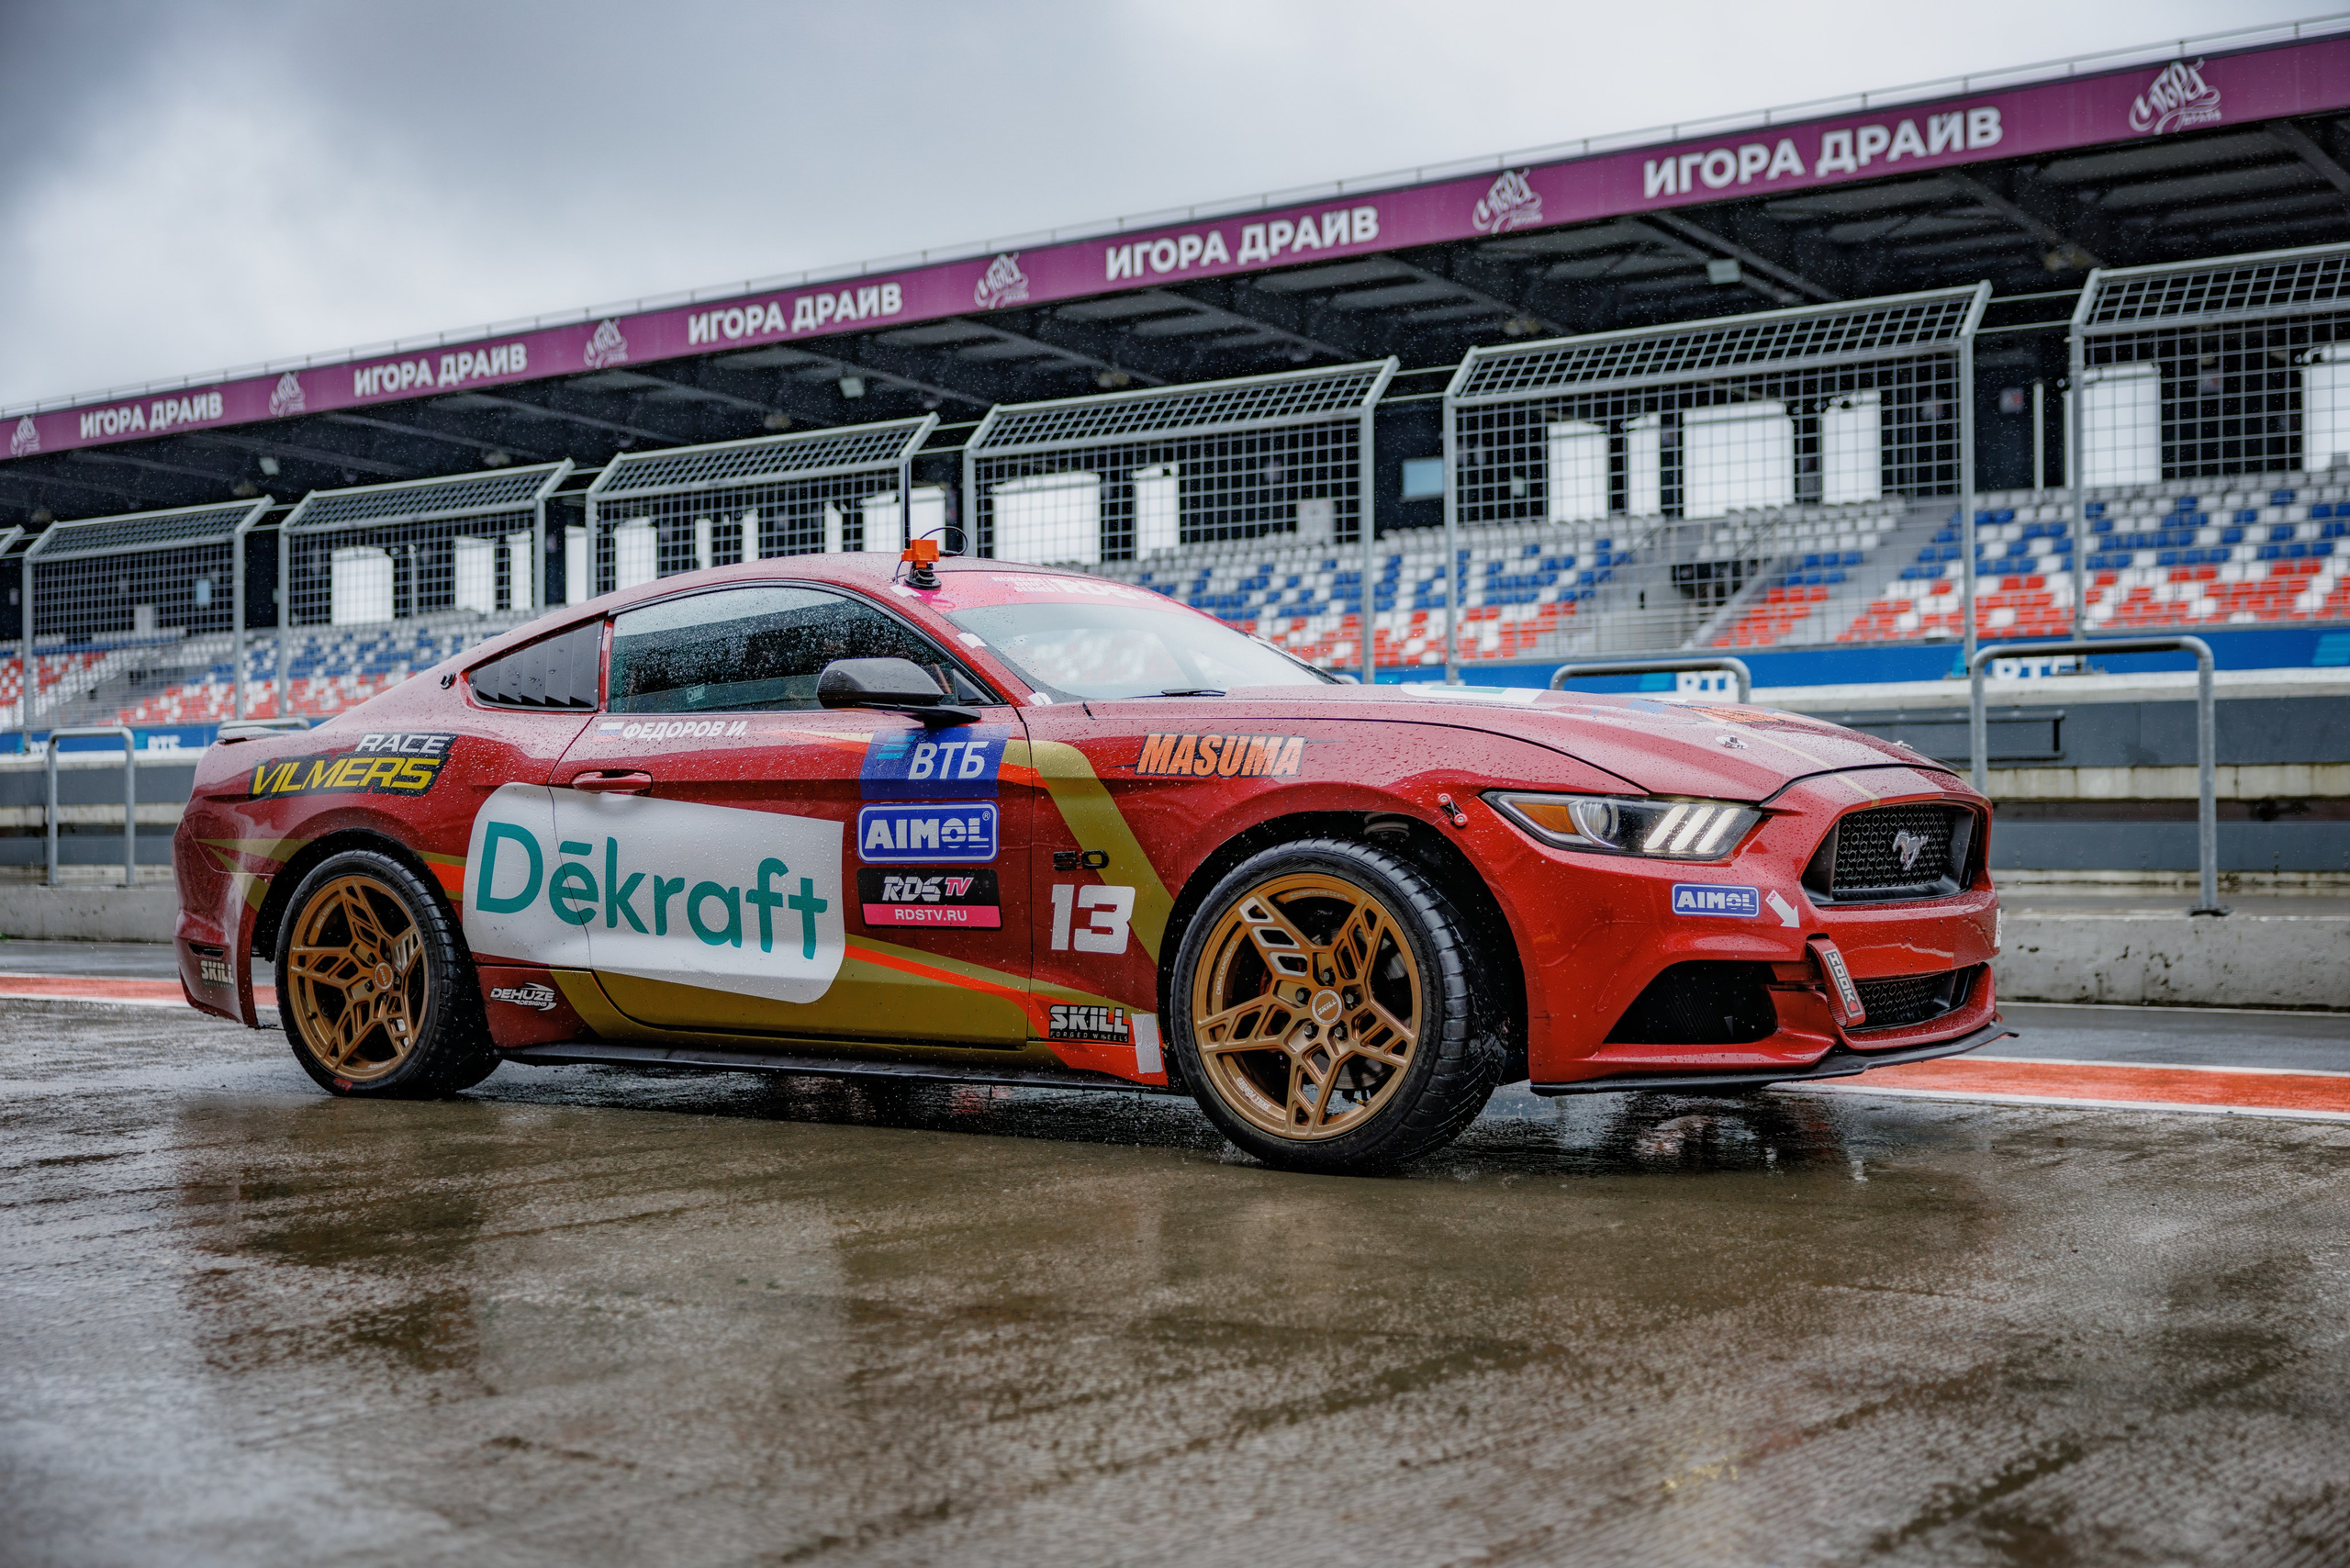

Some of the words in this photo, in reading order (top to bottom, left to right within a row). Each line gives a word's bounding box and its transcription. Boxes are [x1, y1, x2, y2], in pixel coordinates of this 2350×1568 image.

[1644, 140, 1805, 198] ИГОРА
[1816, 107, 2003, 177] ДРАЙВ
[1105, 230, 1230, 281] ИГОРА
[1237, 206, 1380, 266] ДРАЙВ
[688, 302, 787, 345] ИГОРА
[791, 282, 902, 334] ДРАЙВ
[353, 358, 434, 398] ИГОРА
[437, 342, 528, 388] ДРАЙВ
[80, 405, 146, 440] ИГОРА
[149, 391, 223, 432] ДРАЙВ
[354, 734, 451, 755] RACE
[622, 721, 726, 742] ФЕДОРОВ
[725, 721, 748, 737] И.
[907, 741, 990, 780] ВТБ
[1136, 733, 1305, 777] MASUMA
[252, 756, 442, 795] VILMERS
[476, 821, 828, 960] Dēkraft
[882, 876, 945, 902] RDS
[945, 877, 975, 897] TV
[894, 908, 968, 922] RDSTV.RU
[1051, 884, 1136, 955] 13
[200, 959, 234, 985] SKILL
[1827, 953, 1856, 1002] HOOK
[490, 987, 555, 1002] DEHUZE
[519, 1000, 547, 1008] DESIGNS
[1049, 1005, 1129, 1034] SKILL
[1049, 1030, 1089, 1038] FORGED
[1091, 1033, 1129, 1043] WHEELS
